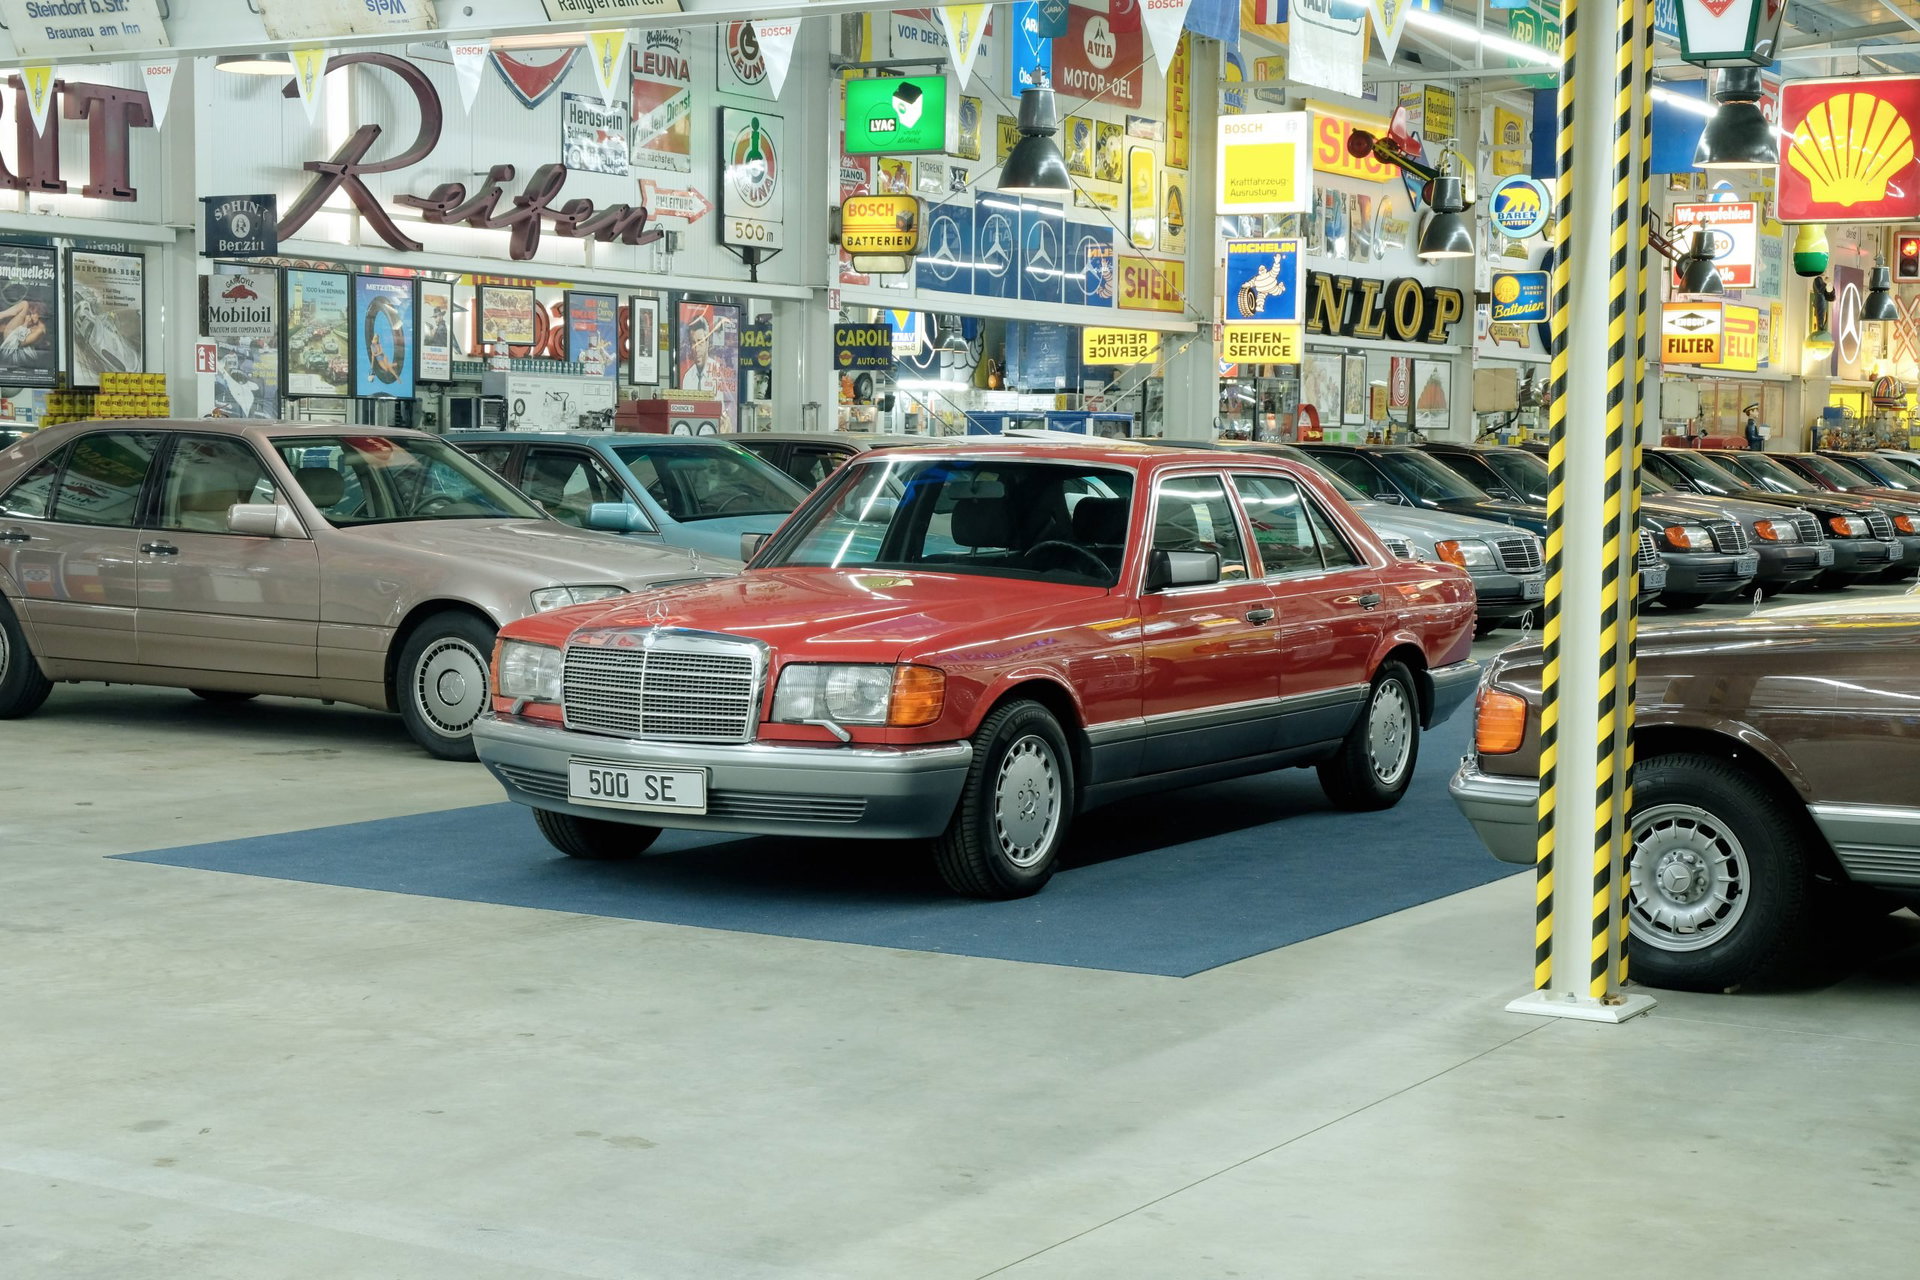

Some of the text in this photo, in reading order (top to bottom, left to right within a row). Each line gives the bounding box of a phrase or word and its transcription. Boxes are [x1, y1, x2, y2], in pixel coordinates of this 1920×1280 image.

[26, 0, 87, 19] Steindorf
[1147, 0, 1184, 9] BOSCH
[45, 22, 141, 40] Braunau am Inn
[760, 26, 792, 37] BOSCH
[898, 23, 918, 40] VOR
[920, 29, 939, 45] DER
[455, 46, 483, 56] BOSCH
[1087, 40, 1113, 59] AVIA
[146, 66, 172, 76] BOSCH
[632, 49, 691, 83] LEUNA
[1063, 66, 1133, 99] MOTOR-OEL
[569, 102, 623, 131] Herbstein
[870, 118, 896, 132] LYAC
[1224, 123, 1263, 134] BOSCH
[275, 52, 665, 261] Reifen
[848, 203, 895, 217] BOSCH
[1676, 207, 1695, 222] Wir
[735, 222, 774, 242] 500 m
[218, 236, 265, 252] Benzin
[847, 235, 912, 247] BATTERIEN
[1229, 242, 1297, 254] MICHELIN
[1124, 265, 1180, 302] SHELL
[209, 305, 271, 323] Mobiloil
[1306, 268, 1464, 345] NLOP
[1493, 300, 1545, 319] Batterien
[210, 326, 230, 334] VACUUM
[836, 328, 890, 347] CAROIL
[1230, 332, 1291, 344] REIFEN-
[1229, 345, 1291, 357] SERVICE
[1668, 338, 1715, 353] FILTER
[589, 769, 676, 802] 500 SE
